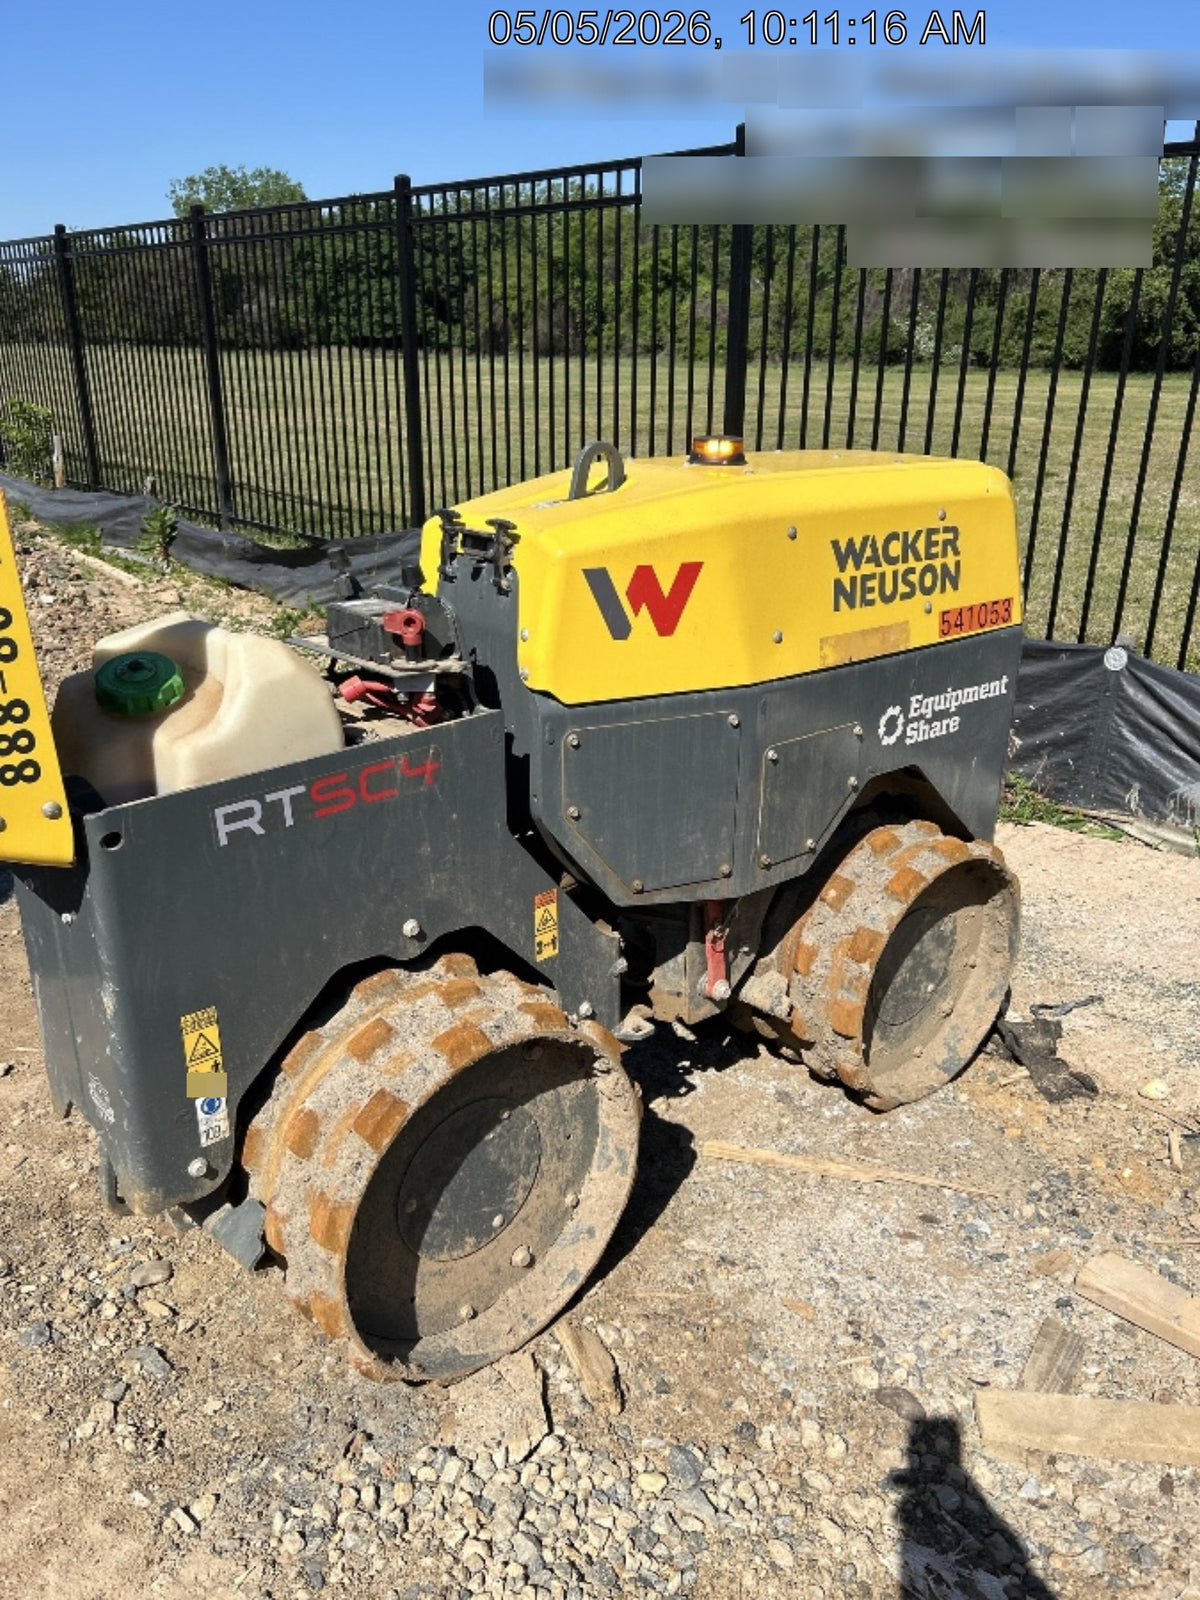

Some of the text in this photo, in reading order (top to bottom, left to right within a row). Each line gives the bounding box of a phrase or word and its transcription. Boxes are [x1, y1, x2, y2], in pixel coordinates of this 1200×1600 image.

[830, 526, 961, 573] WACKER
[833, 559, 961, 612] NEUSON
[940, 598, 1013, 637] 541053
[908, 675, 1008, 719] Equipment
[905, 716, 960, 746] Share
[214, 755, 441, 847] RTSC4
